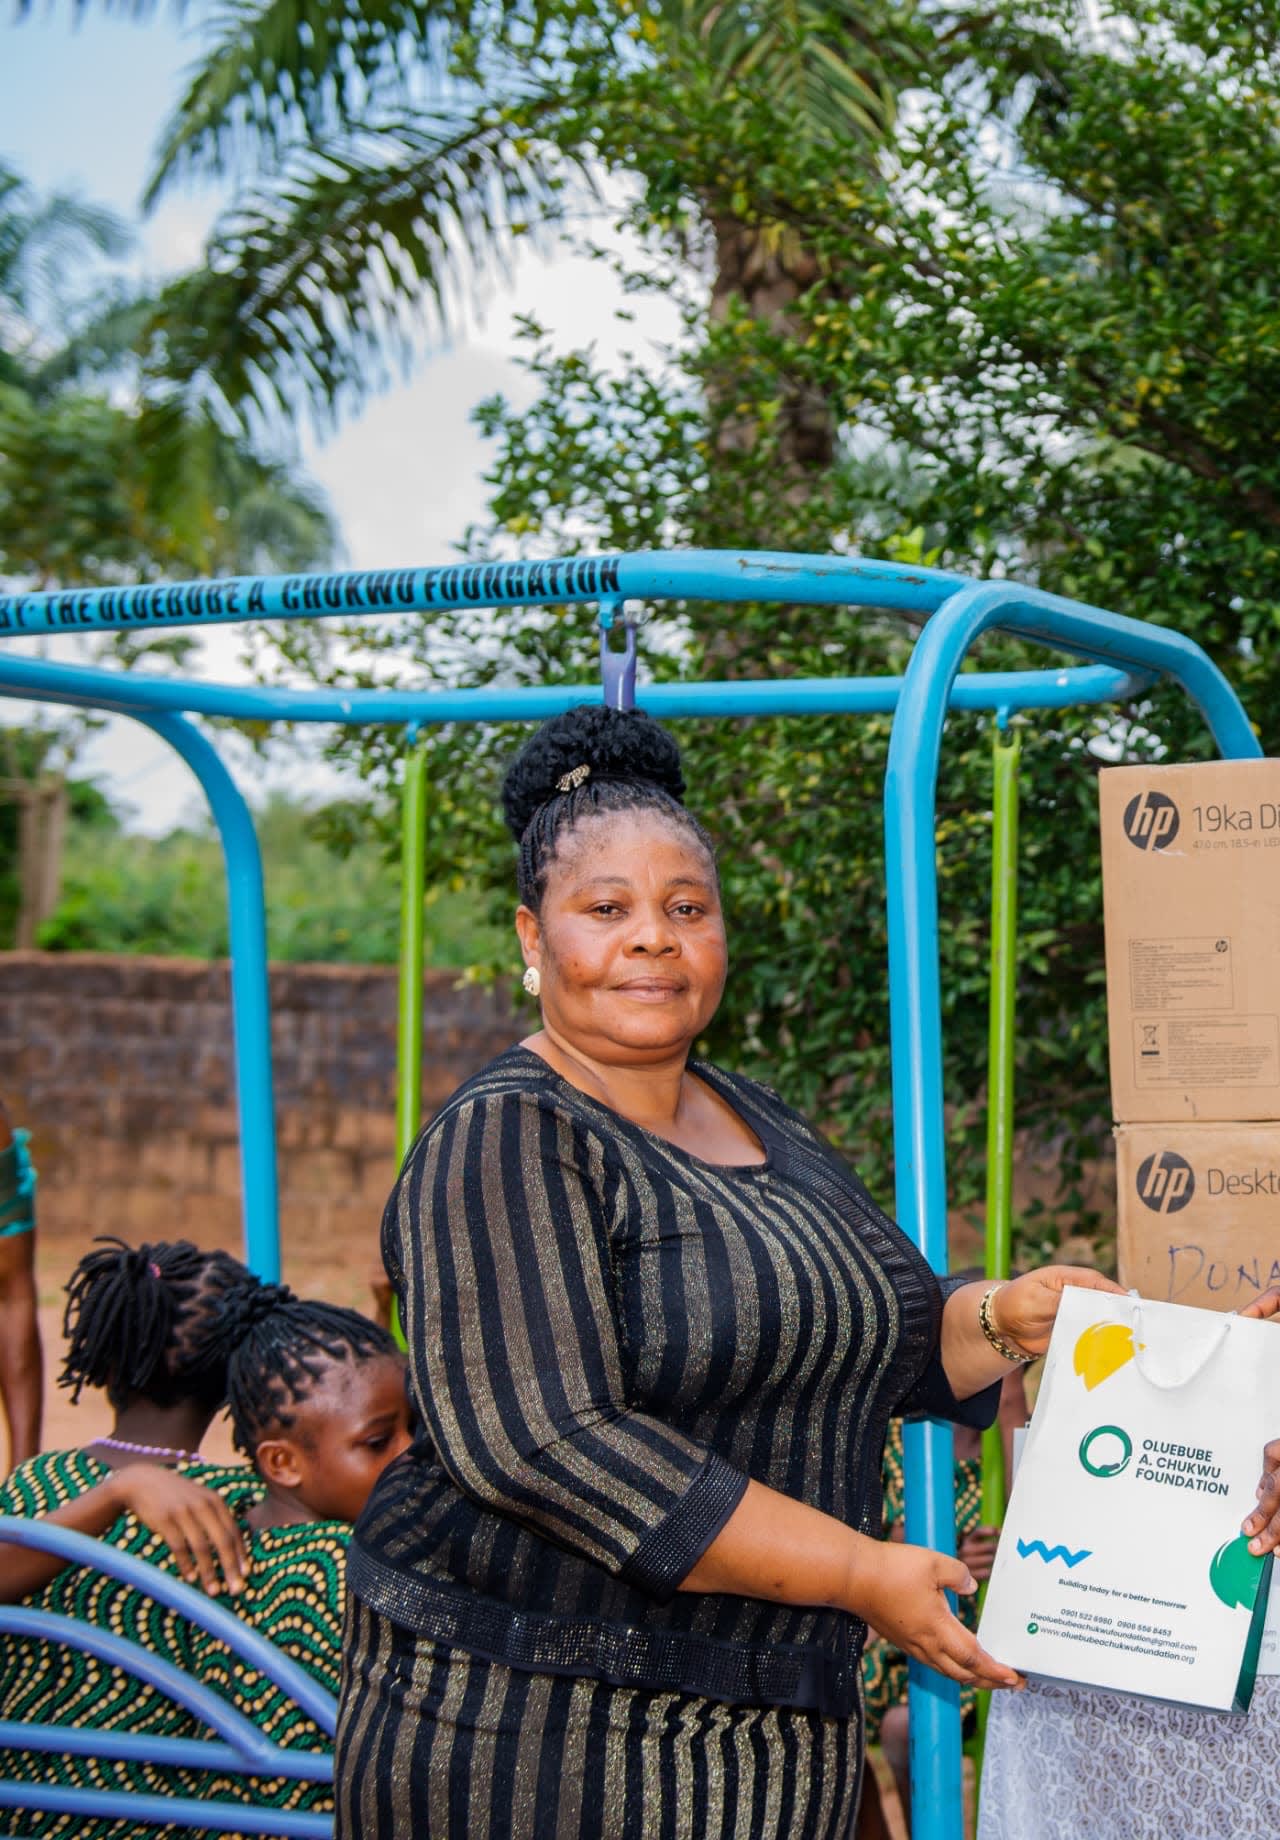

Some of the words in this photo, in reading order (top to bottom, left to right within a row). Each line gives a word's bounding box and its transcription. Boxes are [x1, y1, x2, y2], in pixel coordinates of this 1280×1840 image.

[45, 592, 94, 626] THE
[246, 580, 267, 614] A
[281, 569, 416, 610] CHUKWU
[423, 558, 622, 602] FOUNDATION
[1124, 791, 1179, 850] hp
[1192, 804, 1252, 832] 19ka
[1137, 1151, 1195, 1214] hp
[1138, 1453, 1153, 1466] A.
[1156, 1457, 1221, 1479] CHUKWU
[1142, 1439, 1213, 1463] OLUEBUBE
[1135, 1467, 1230, 1496] FOUNDATION
[1058, 1578, 1088, 1591] Building
[1089, 1584, 1110, 1597] today
[1111, 1589, 1123, 1598] for
[1129, 1593, 1151, 1604] better
[1151, 1598, 1188, 1610] tomorrow
